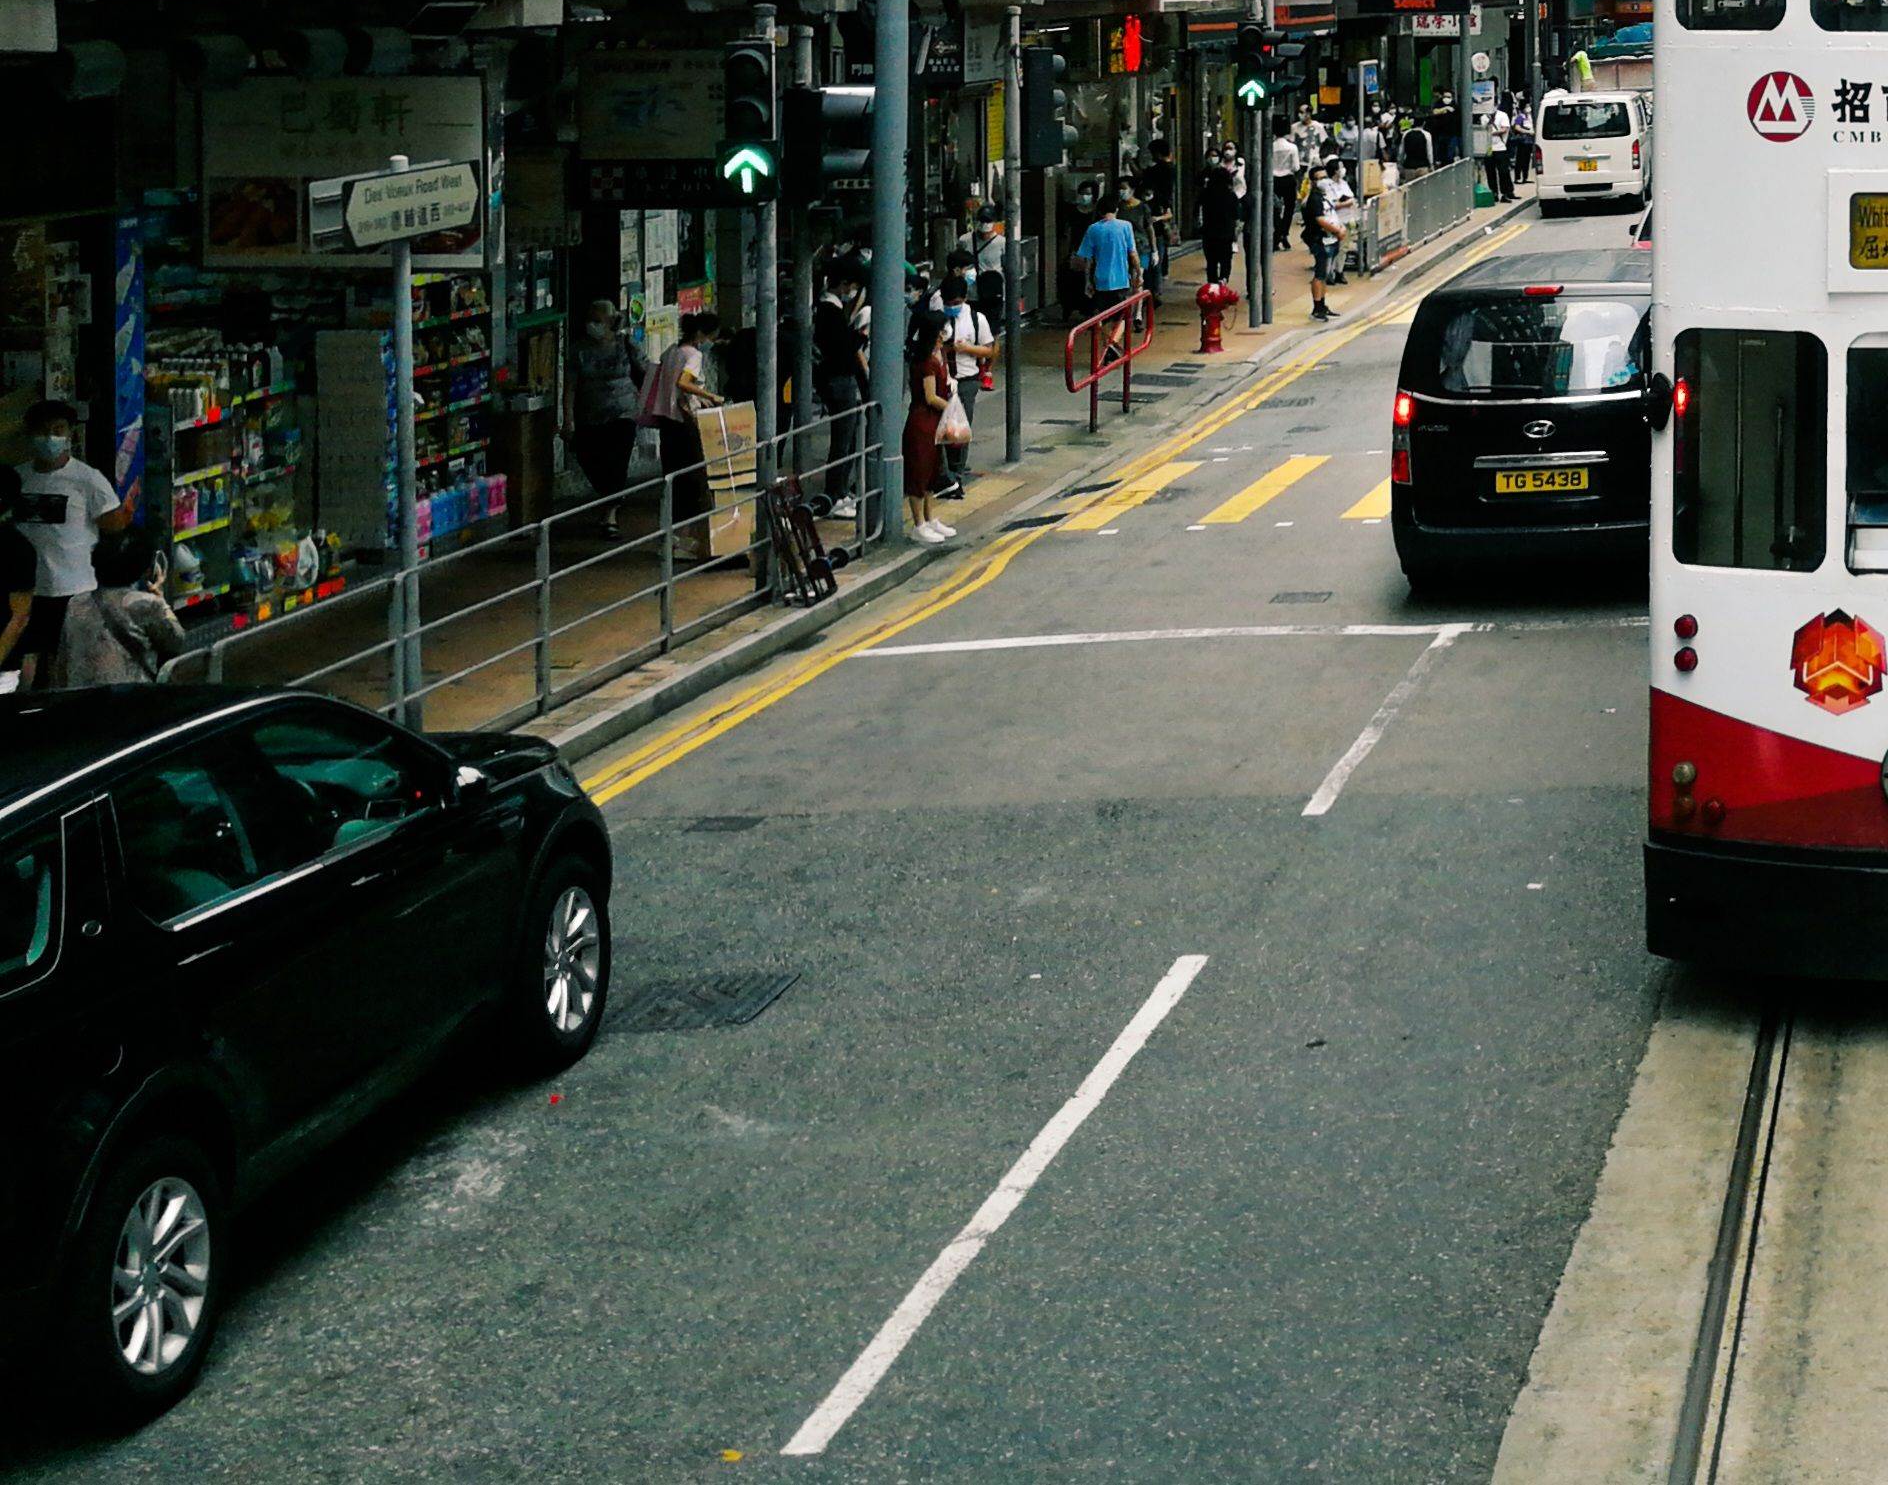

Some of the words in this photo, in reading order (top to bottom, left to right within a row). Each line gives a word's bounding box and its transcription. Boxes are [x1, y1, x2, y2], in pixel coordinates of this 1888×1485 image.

[1833, 130, 1882, 144] CMB
[1502, 473, 1527, 489] TG
[1532, 471, 1582, 488] 5438
